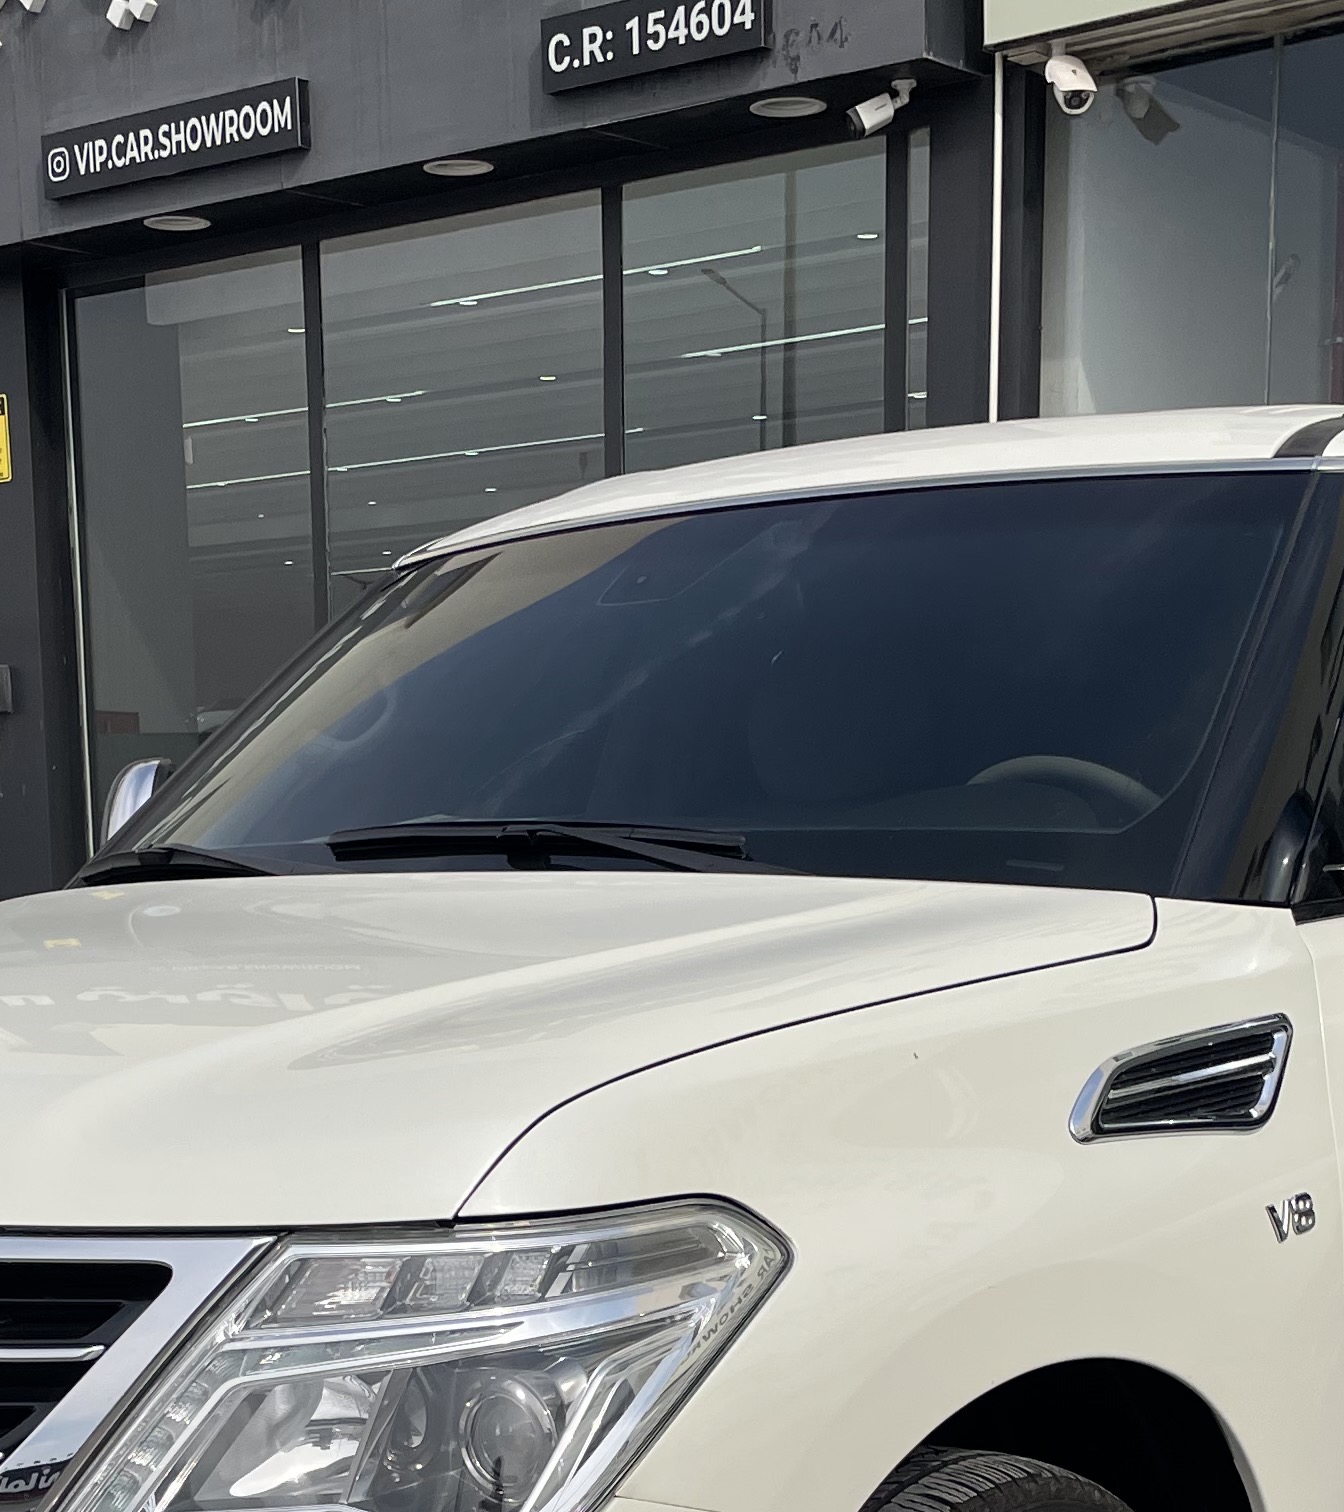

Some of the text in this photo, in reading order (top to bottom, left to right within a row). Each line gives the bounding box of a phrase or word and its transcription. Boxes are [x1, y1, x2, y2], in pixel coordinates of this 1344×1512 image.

[547, 25, 614, 73] C.R:
[625, 0, 756, 55] 154604
[74, 96, 293, 176] VIP.CAR.SHOWROOM
[1265, 1191, 1316, 1244] V8
